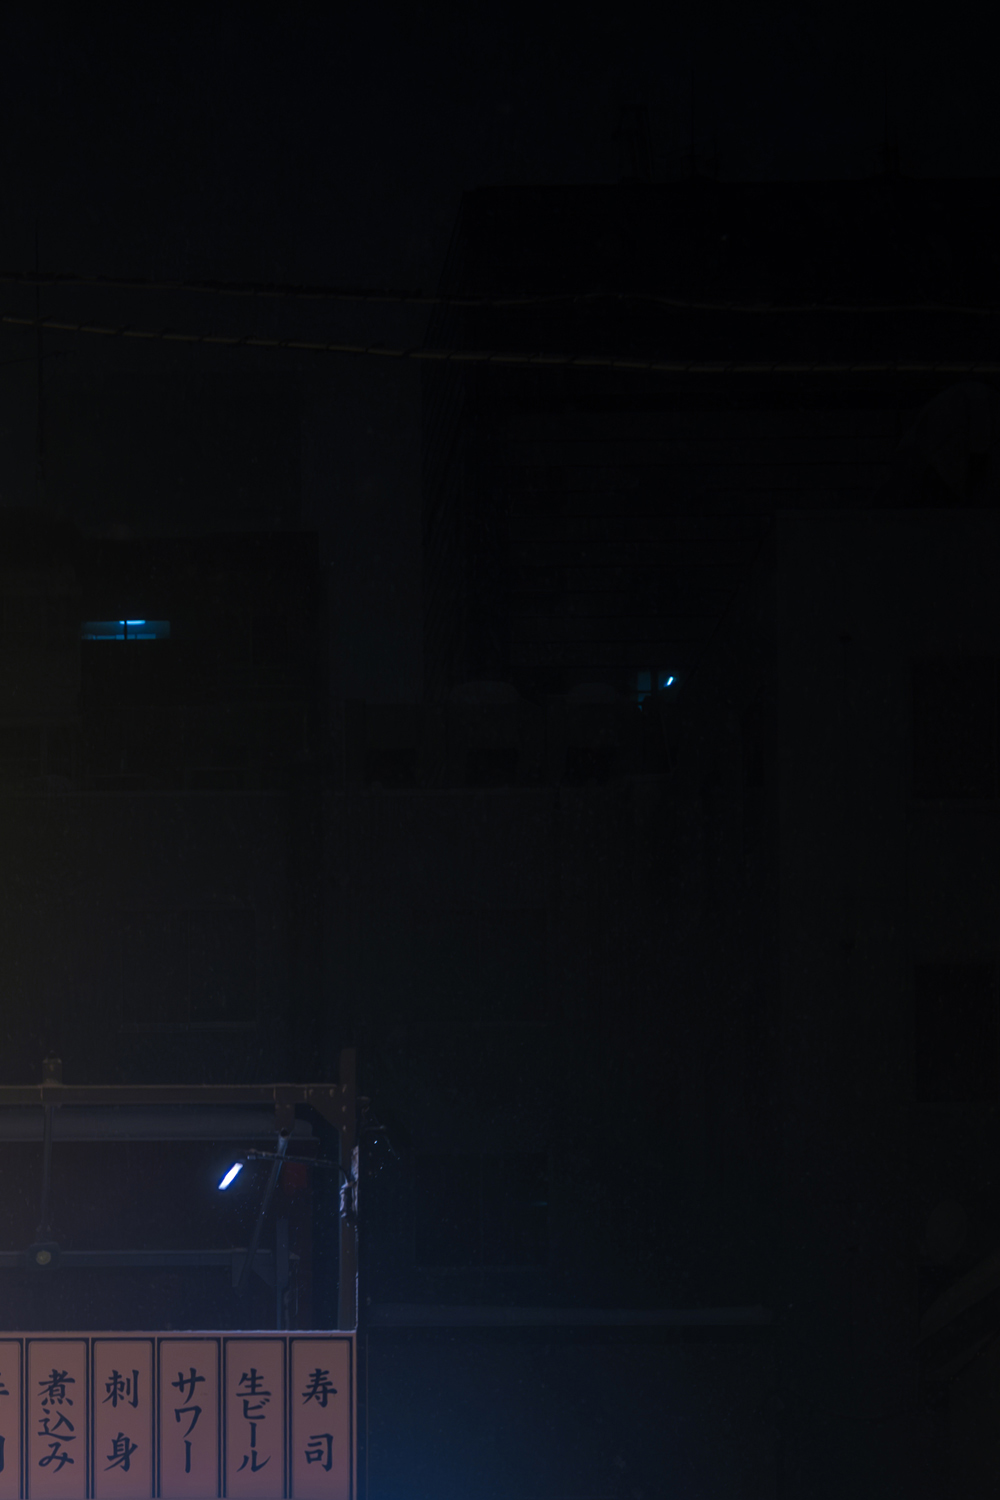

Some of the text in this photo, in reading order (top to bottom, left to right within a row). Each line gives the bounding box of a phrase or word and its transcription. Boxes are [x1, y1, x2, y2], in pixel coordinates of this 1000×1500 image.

[38, 1369, 76, 1472] 煮込み
[103, 1370, 139, 1471] 刺身
[172, 1368, 205, 1473] サワー
[236, 1368, 271, 1472] 生ビール
[302, 1369, 337, 1471] 寿司
